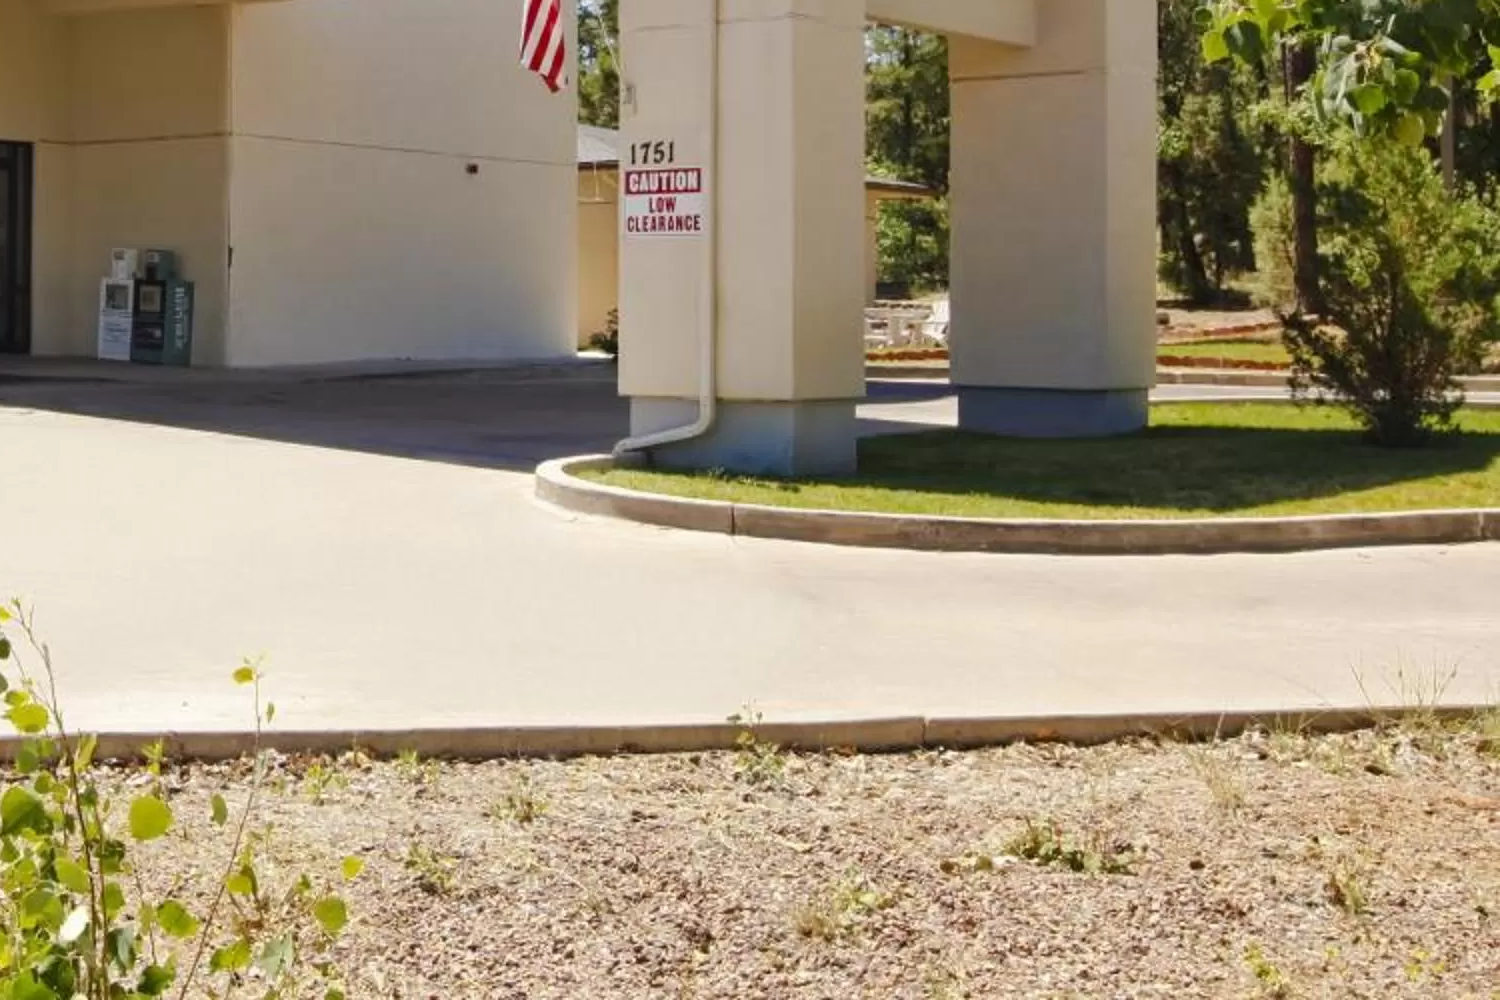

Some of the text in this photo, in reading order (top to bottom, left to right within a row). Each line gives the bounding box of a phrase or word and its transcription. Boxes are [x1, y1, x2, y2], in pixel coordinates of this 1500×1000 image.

[630, 140, 675, 165] 1751
[628, 170, 699, 192] CAUTION
[648, 197, 676, 213] LOW
[627, 214, 701, 232] CLEARANCE
